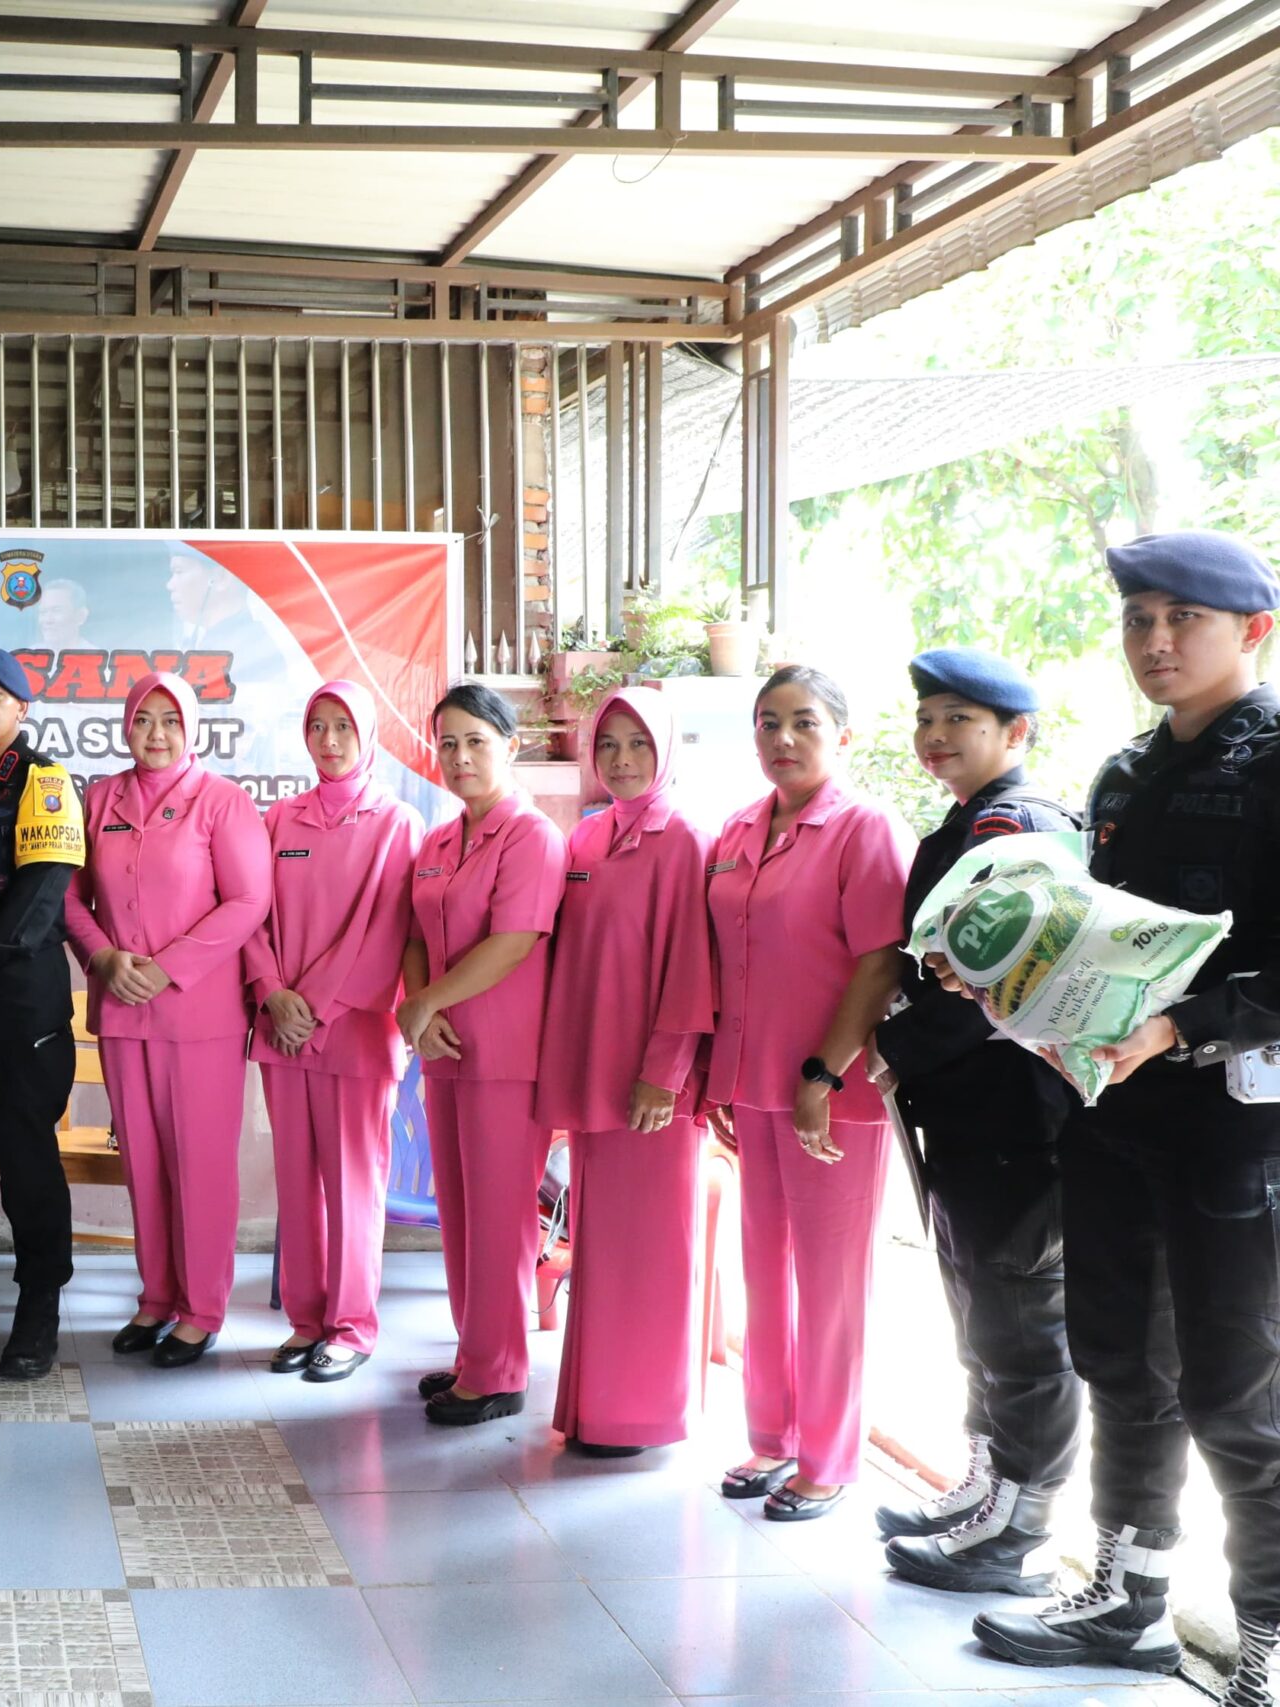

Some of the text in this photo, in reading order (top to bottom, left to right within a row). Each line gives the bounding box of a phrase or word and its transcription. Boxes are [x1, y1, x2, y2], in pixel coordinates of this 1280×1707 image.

[239, 780, 306, 801] OLRI
[20, 824, 82, 843] WAKAOPSDA
[1047, 984, 1080, 1025] Kilang
